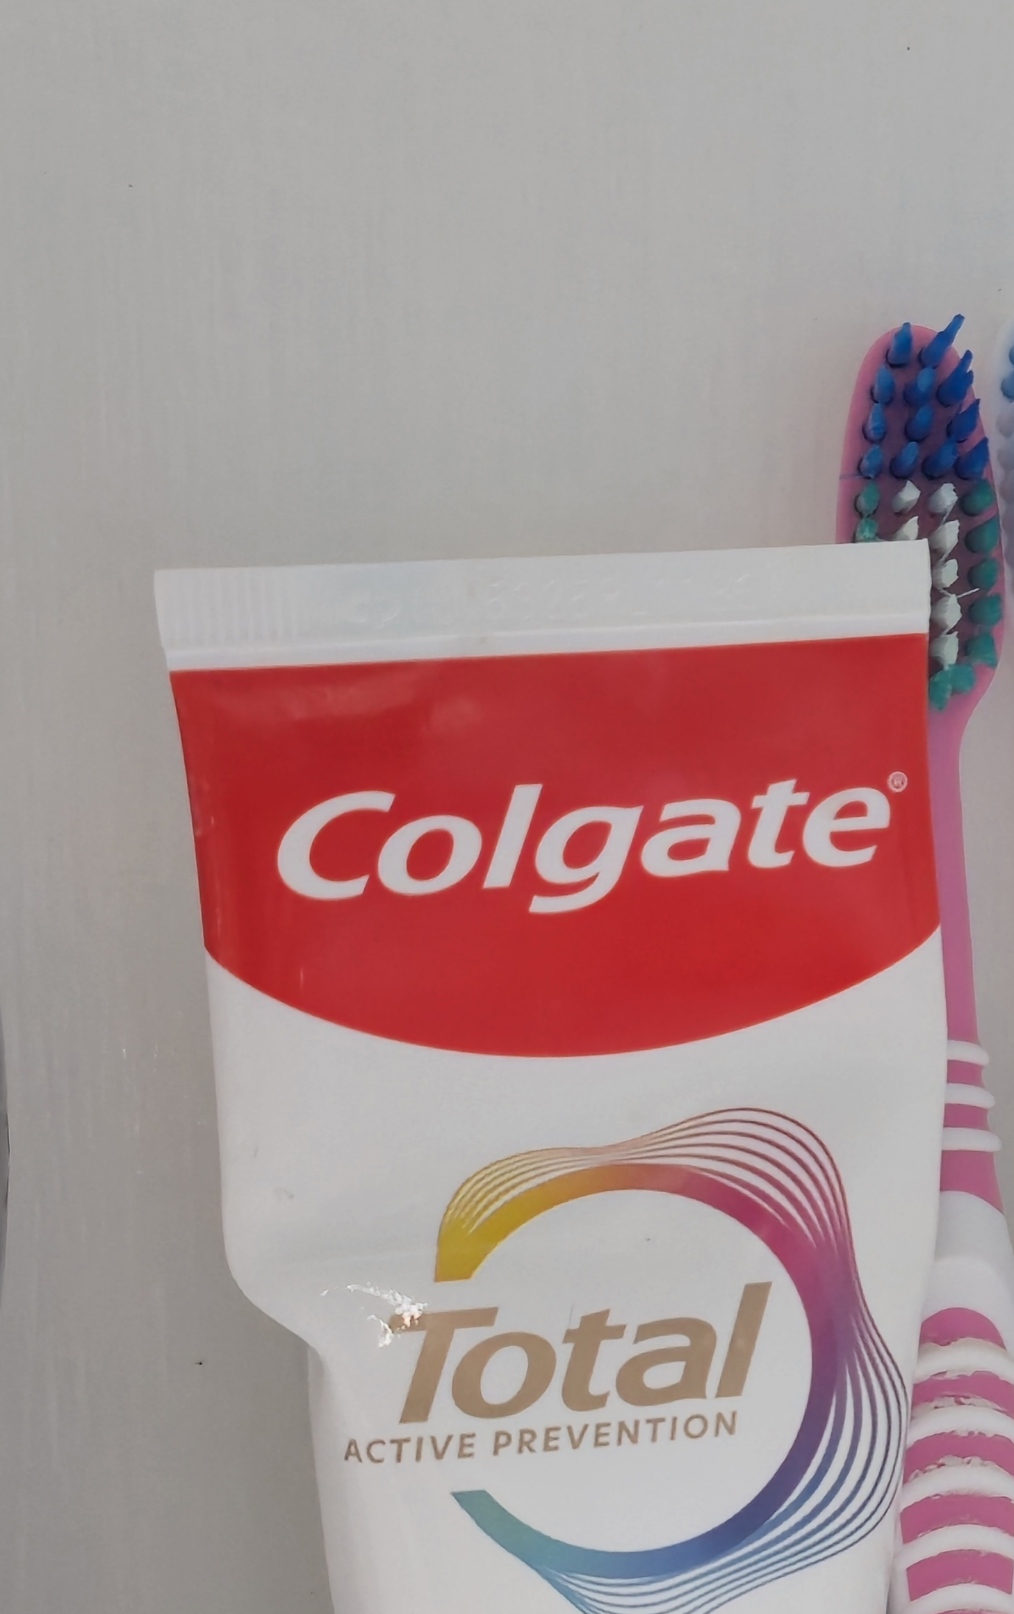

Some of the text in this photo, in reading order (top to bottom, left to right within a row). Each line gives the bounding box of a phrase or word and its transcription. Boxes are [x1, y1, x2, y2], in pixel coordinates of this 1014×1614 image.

[388, 1281, 773, 1425] Total
[343, 1410, 738, 1464] ACTIVE PREVENTION
